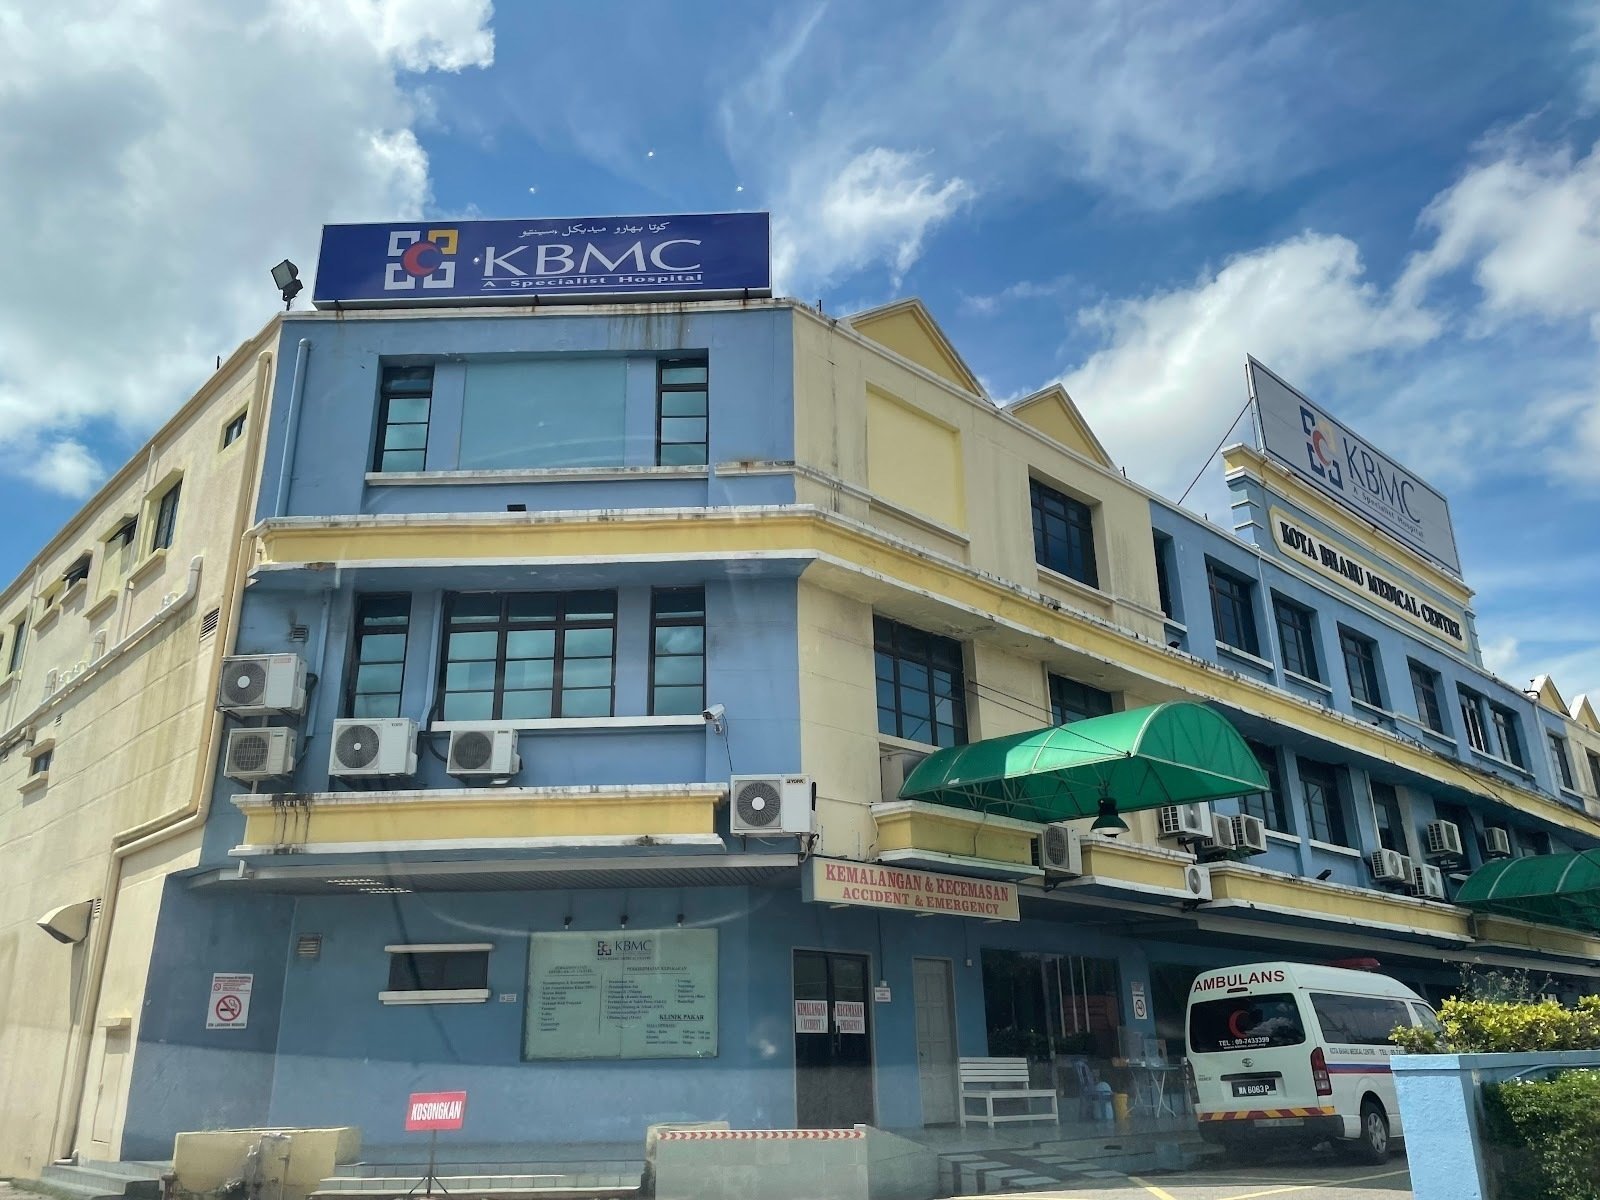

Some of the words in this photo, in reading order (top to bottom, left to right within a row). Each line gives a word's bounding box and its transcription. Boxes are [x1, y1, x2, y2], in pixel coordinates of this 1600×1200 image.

[483, 239, 702, 277] KBMC
[483, 280, 496, 288] A
[510, 276, 606, 288] Specialist
[618, 273, 702, 285] Hospital
[1343, 436, 1420, 524] KBMC
[1280, 521, 1319, 561] KOTA
[1366, 571, 1421, 618] MEDICAL
[1420, 603, 1463, 641] CENTRE
[825, 863, 922, 892] KEMALANGAN
[924, 876, 934, 892] &
[936, 878, 1009, 902] KECEMASAN
[842, 887, 910, 905] ACCIDENT
[915, 895, 924, 907] &
[926, 895, 1000, 915] EMERGENCY
[615, 939, 652, 951] KBMC
[1193, 970, 1285, 992] AMBULANS
[1218, 1039, 1231, 1047] TEL
[1264, 1084, 1270, 1092] P
[411, 1100, 462, 1121] KOSONGKAN
